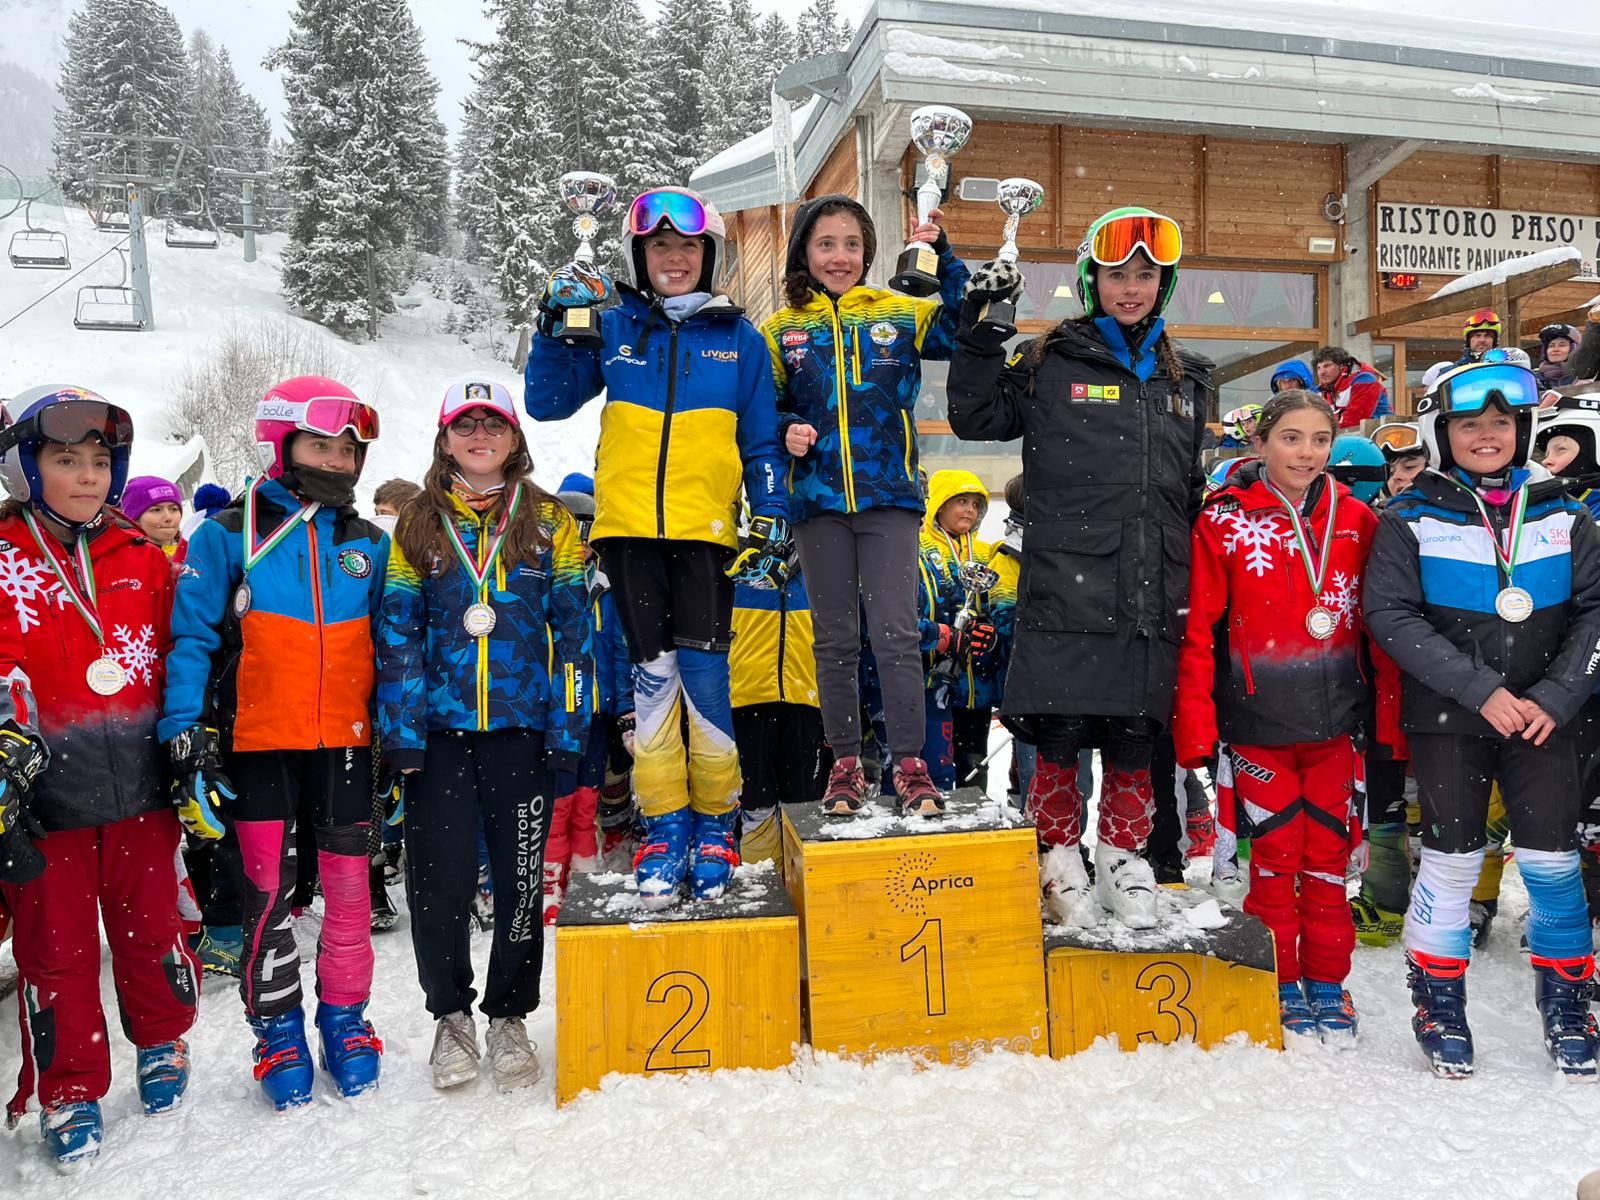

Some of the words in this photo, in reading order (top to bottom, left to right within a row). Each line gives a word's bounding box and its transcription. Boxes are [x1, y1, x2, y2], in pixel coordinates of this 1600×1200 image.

[1380, 206, 1497, 238] RISTORO
[1511, 214, 1584, 243] PASO'
[1379, 243, 1461, 270] RISTORANTE
[575, 669, 584, 707] VITALINI
[517, 803, 529, 877] SCIATORI
[508, 880, 528, 943] CIRCOLO
[912, 874, 974, 895] Aprica
[901, 919, 946, 1016] 1
[645, 971, 711, 1071] 2
[1136, 961, 1197, 1043] 3
